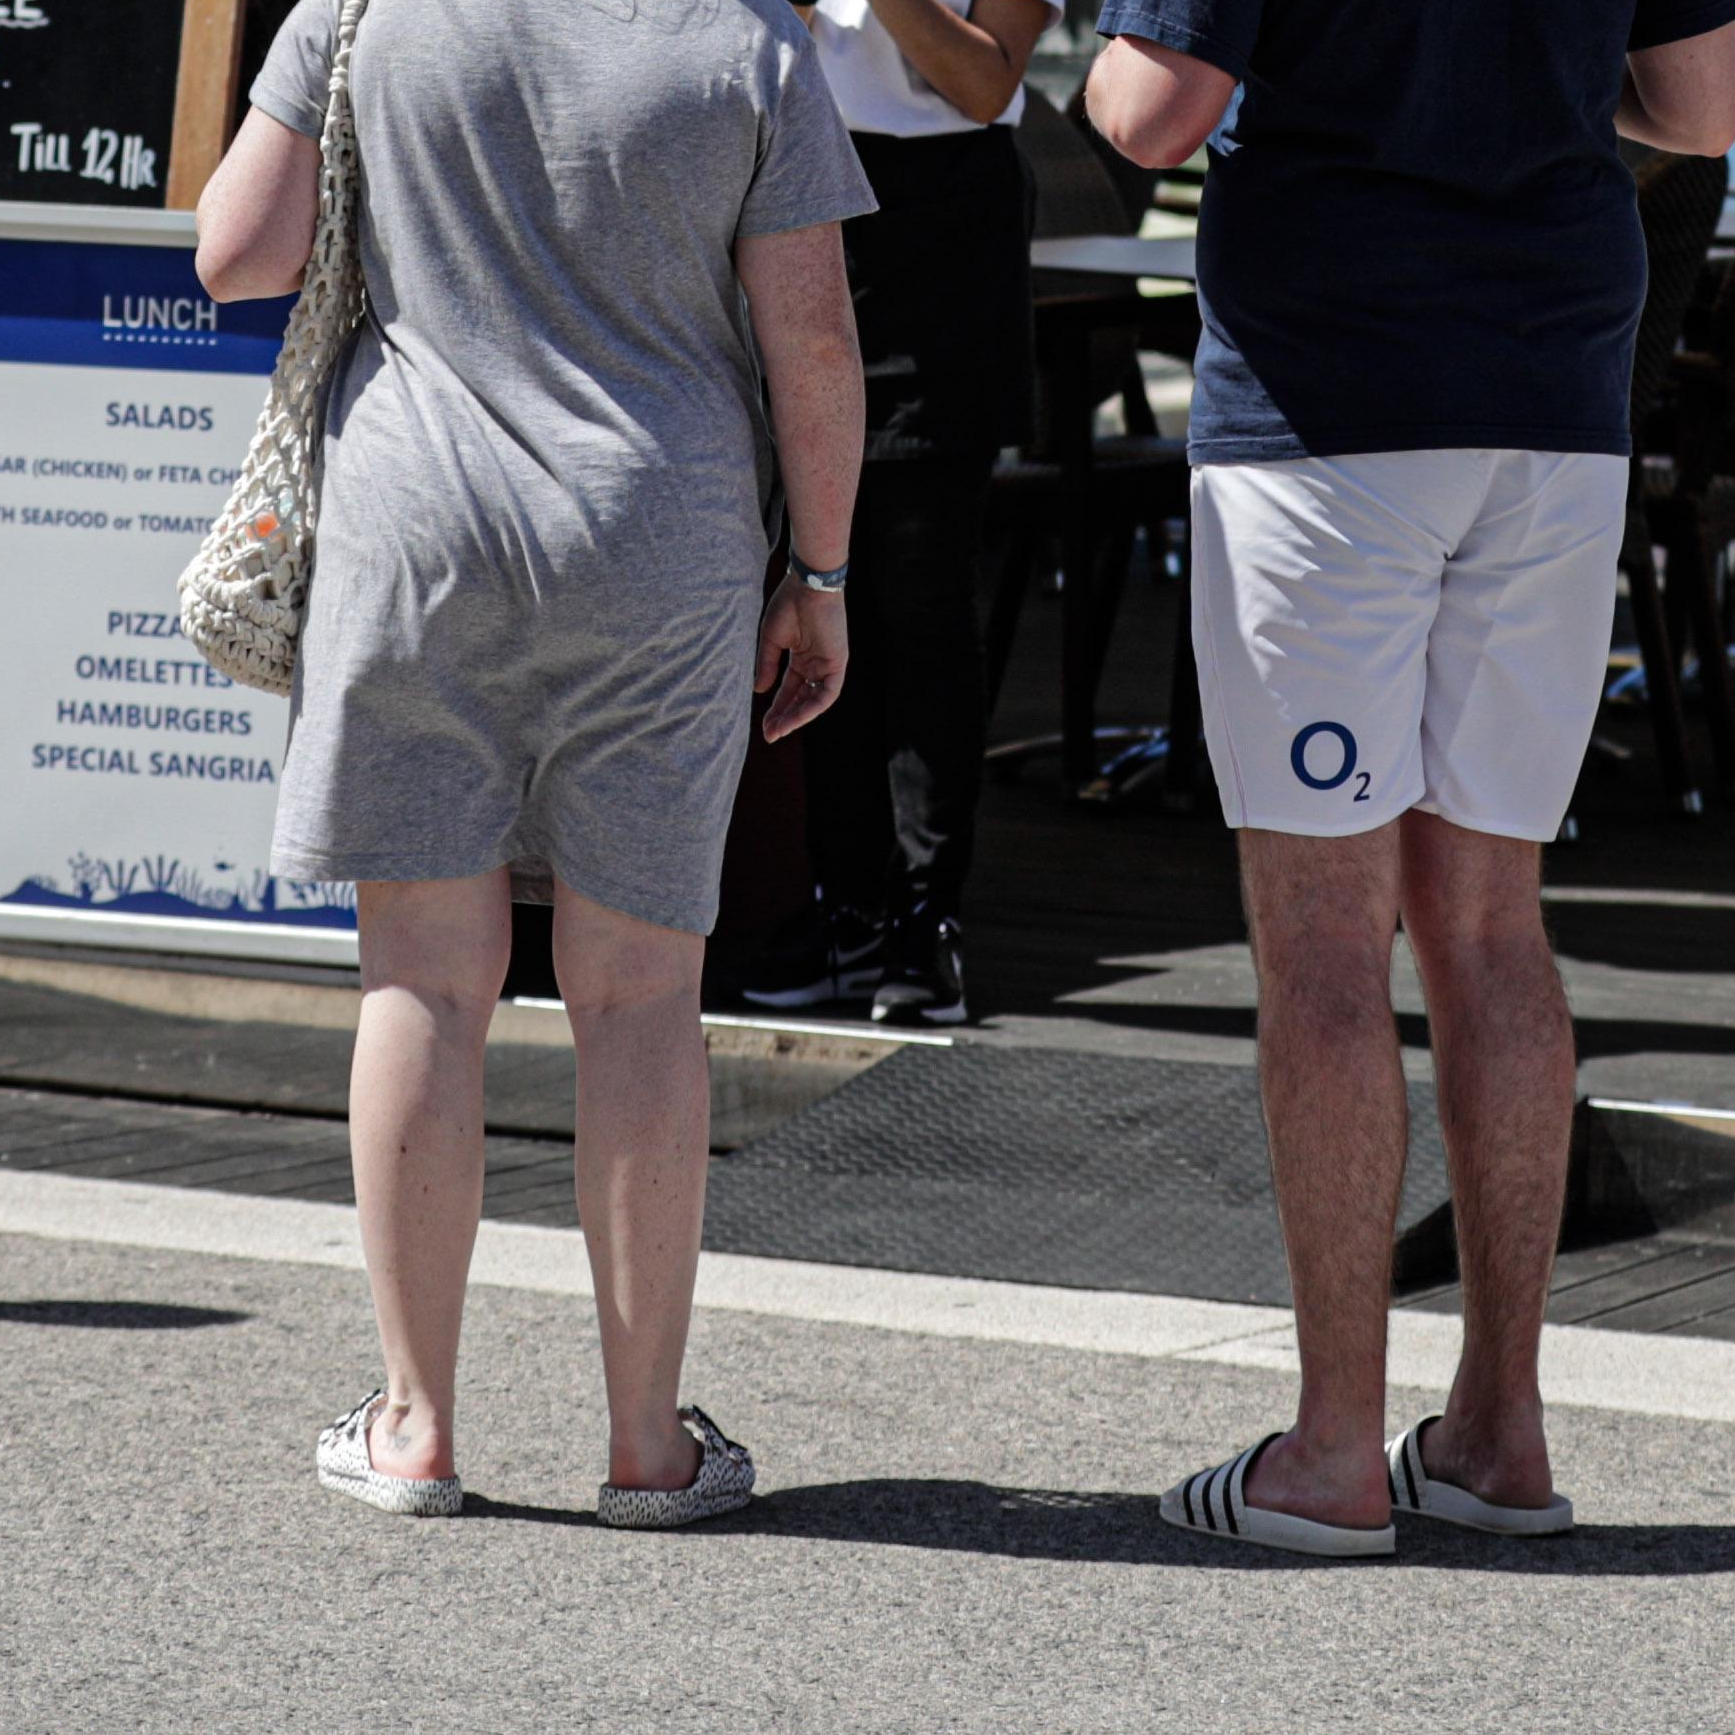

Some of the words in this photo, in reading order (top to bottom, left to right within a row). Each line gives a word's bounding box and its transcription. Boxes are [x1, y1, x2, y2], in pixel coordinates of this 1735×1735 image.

[102, 295, 218, 332] LUNCH
[106, 401, 214, 432] SALADS
[30, 455, 129, 484] (CHICKEN)
[133, 467, 154, 481] or
[158, 464, 202, 483] FETA
[20, 507, 109, 529] SEAFOOD
[112, 517, 133, 530] or
[73, 653, 234, 689] OMELETTES
[57, 700, 252, 736] HAMBURGERS
[32, 743, 141, 775] SPECIAL
[149, 751, 275, 784] SANGRIA
